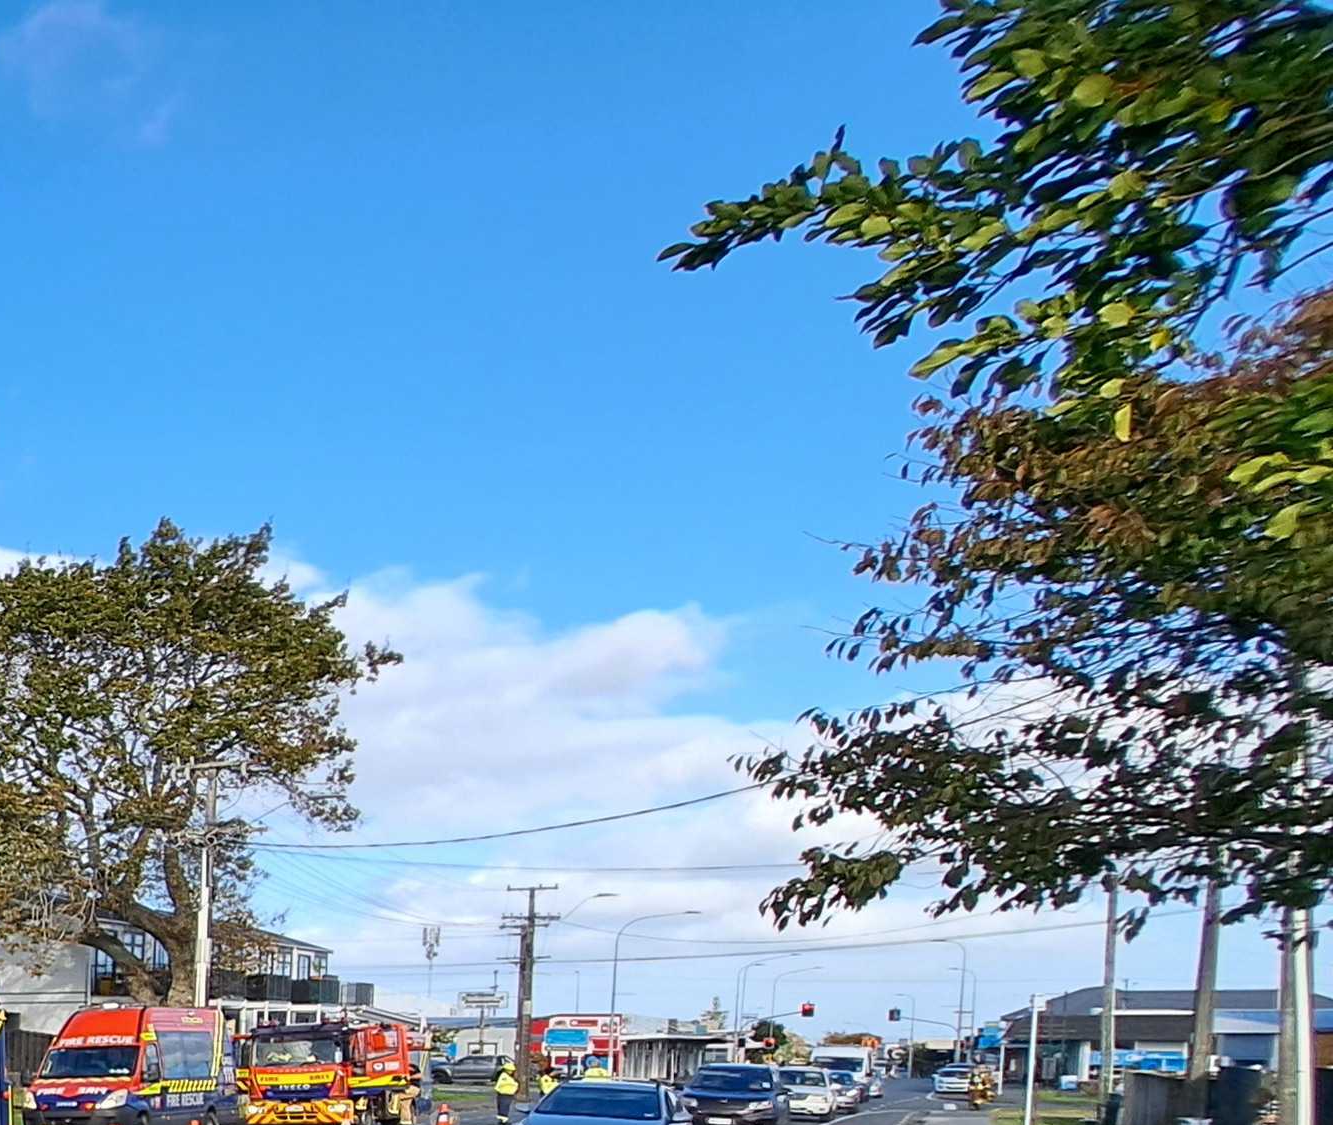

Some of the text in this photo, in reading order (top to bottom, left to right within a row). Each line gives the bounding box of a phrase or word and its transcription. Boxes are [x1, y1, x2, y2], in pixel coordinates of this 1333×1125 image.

[58, 1035, 134, 1047] FIRE RESCUE
[166, 1094, 180, 1106] FIRE
